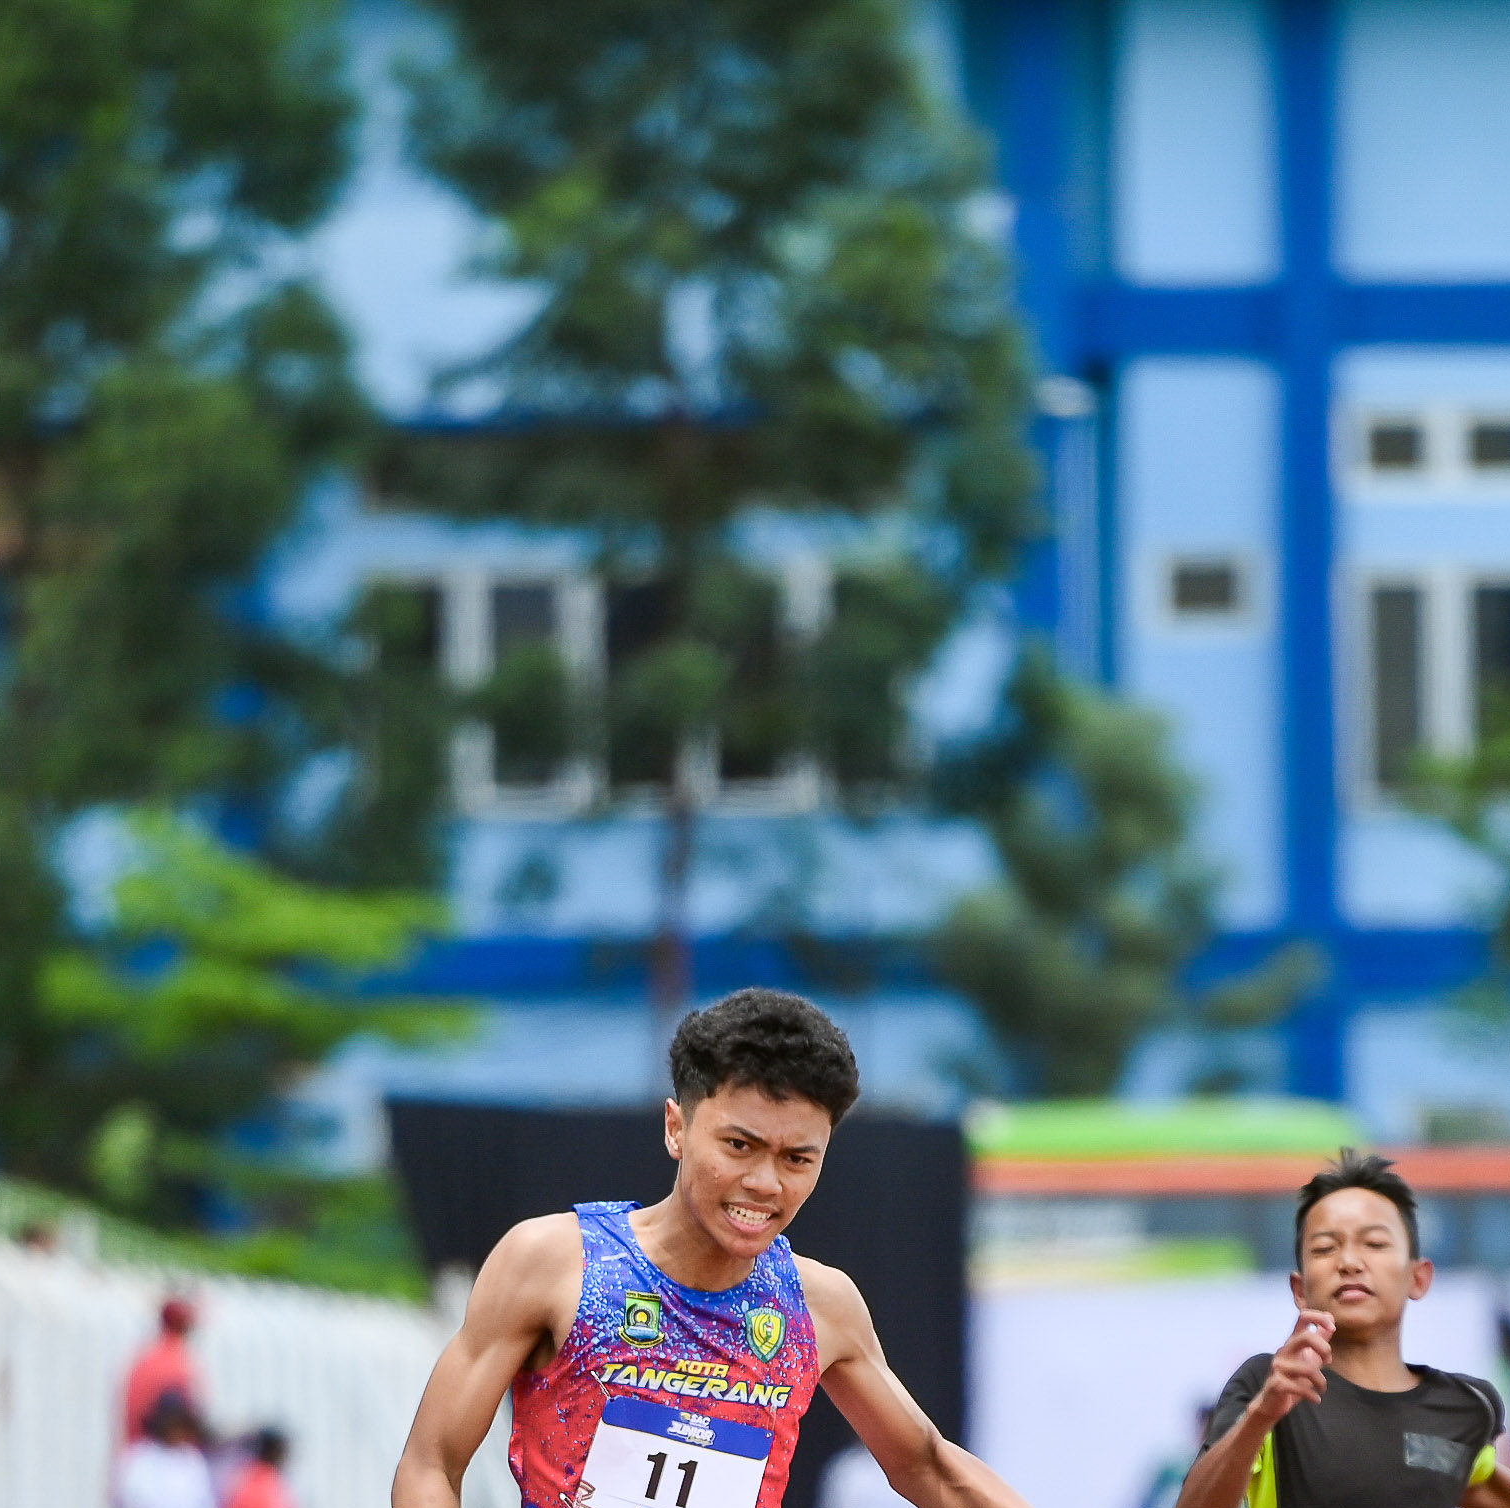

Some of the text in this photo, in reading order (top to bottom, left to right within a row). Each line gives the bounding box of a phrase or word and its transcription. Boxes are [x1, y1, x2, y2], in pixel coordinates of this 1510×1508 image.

[600, 1363, 791, 1407] TANGERANG
[675, 1359, 730, 1377] KOTA
[645, 1451, 698, 1508] 11
